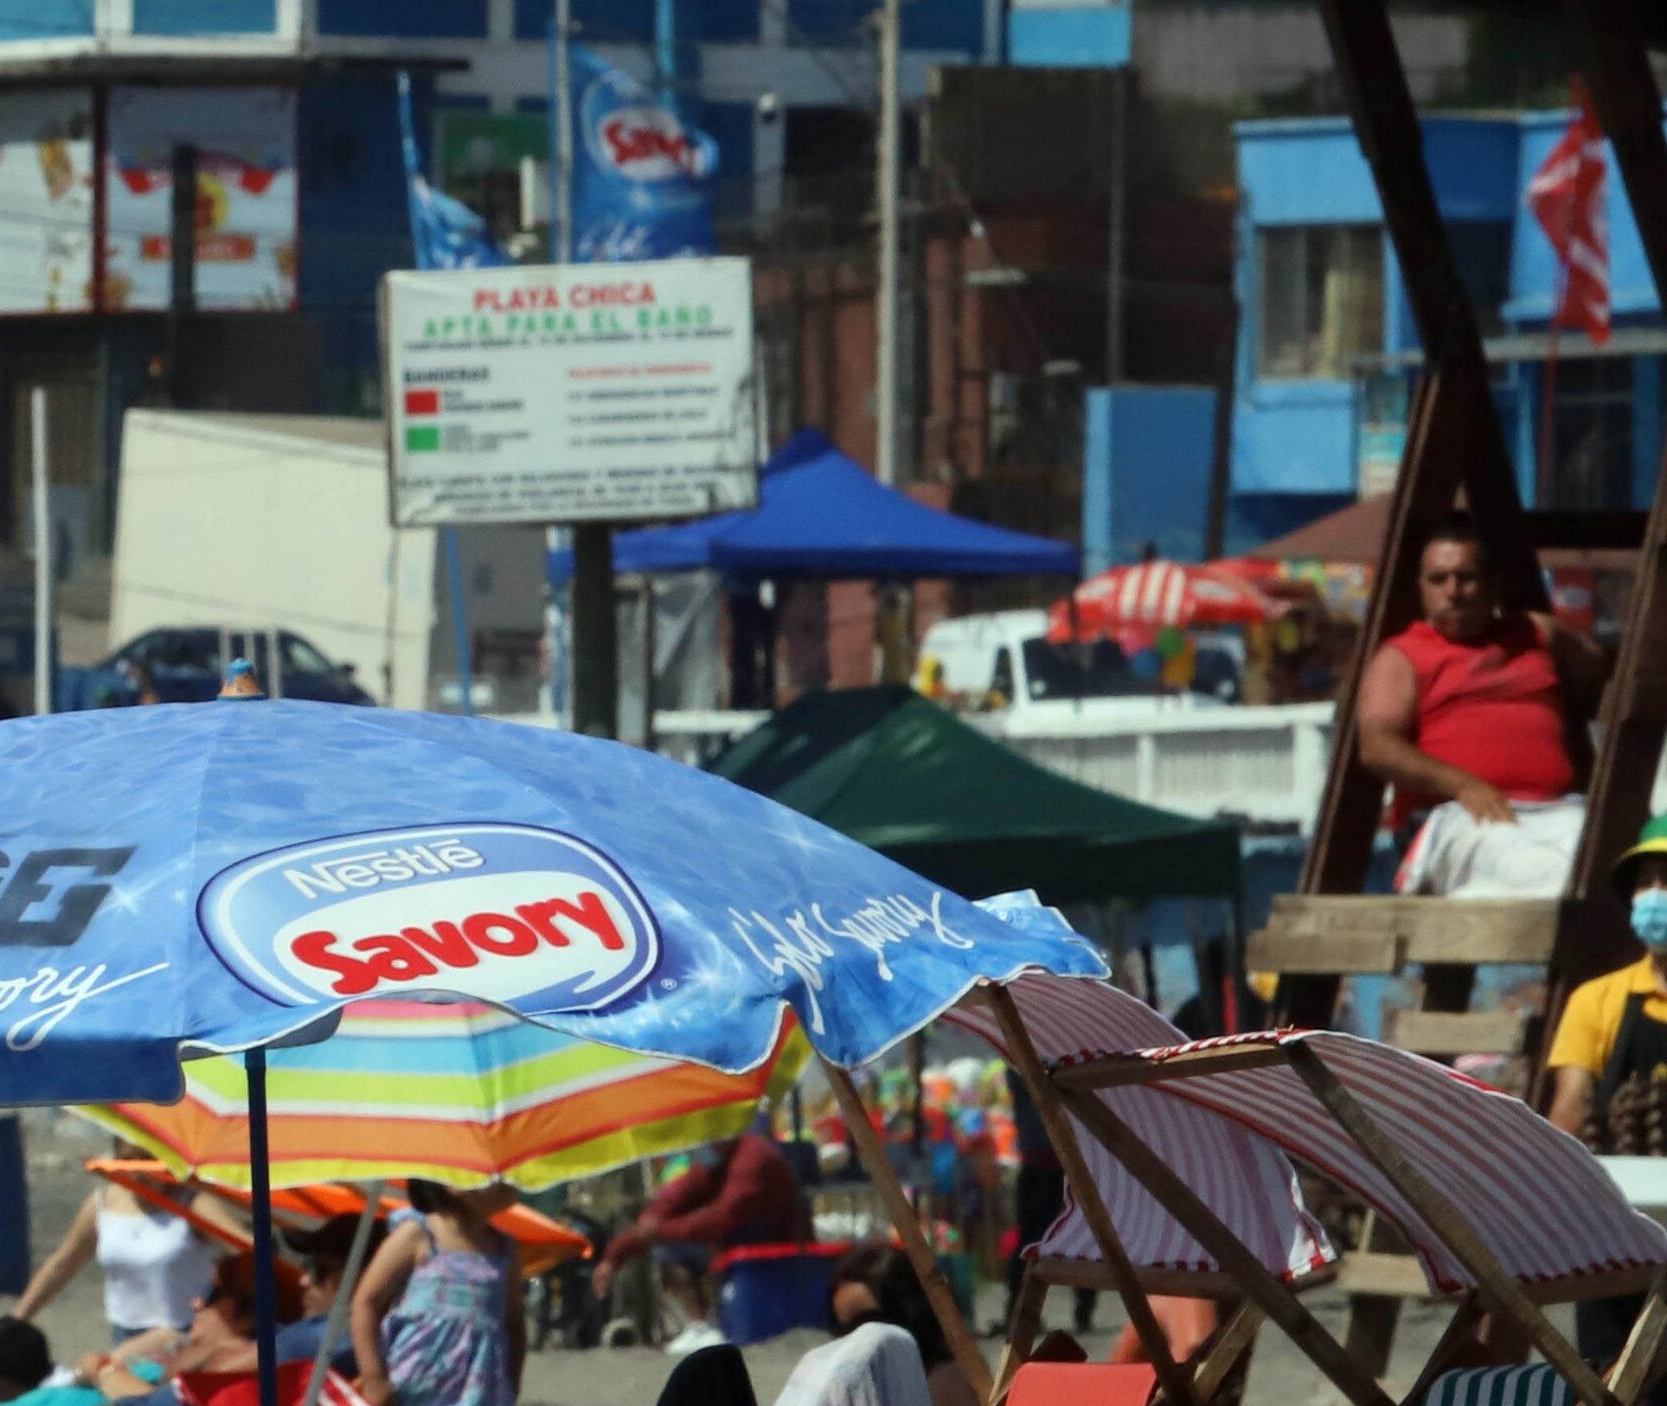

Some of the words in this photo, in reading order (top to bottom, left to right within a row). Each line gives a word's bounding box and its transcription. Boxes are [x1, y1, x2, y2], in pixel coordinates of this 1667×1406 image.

[425, 316, 493, 338] APTA
[505, 312, 575, 335] PARA
[591, 309, 622, 331] EL
[637, 304, 713, 328] BAÑO
[474, 286, 560, 313] PLAYA
[569, 281, 656, 308] CHICA
[291, 891, 625, 994] Savory
[810, 890, 975, 982] Savory
